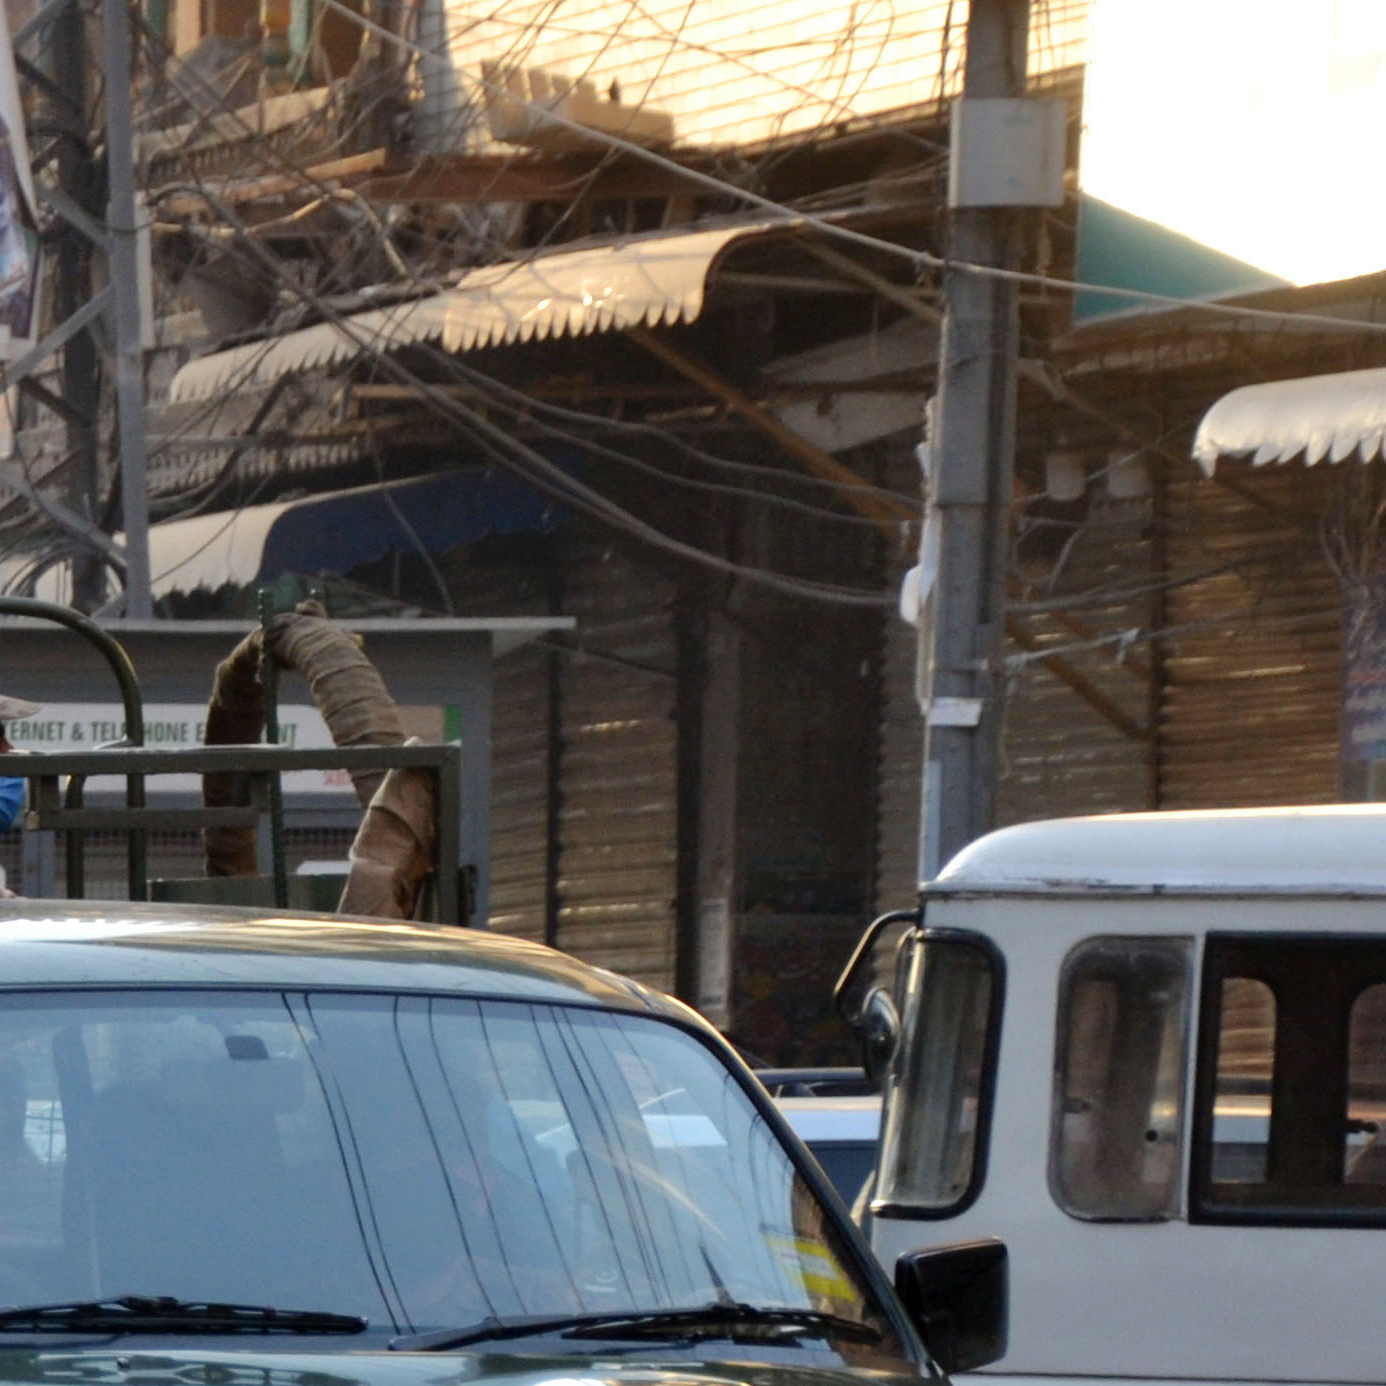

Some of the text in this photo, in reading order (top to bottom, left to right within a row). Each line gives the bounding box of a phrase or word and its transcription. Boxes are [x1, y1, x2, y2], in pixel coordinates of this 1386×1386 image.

[3, 721, 64, 742] TERNET
[71, 722, 84, 742] &
[91, 721, 188, 743] TELHONE
